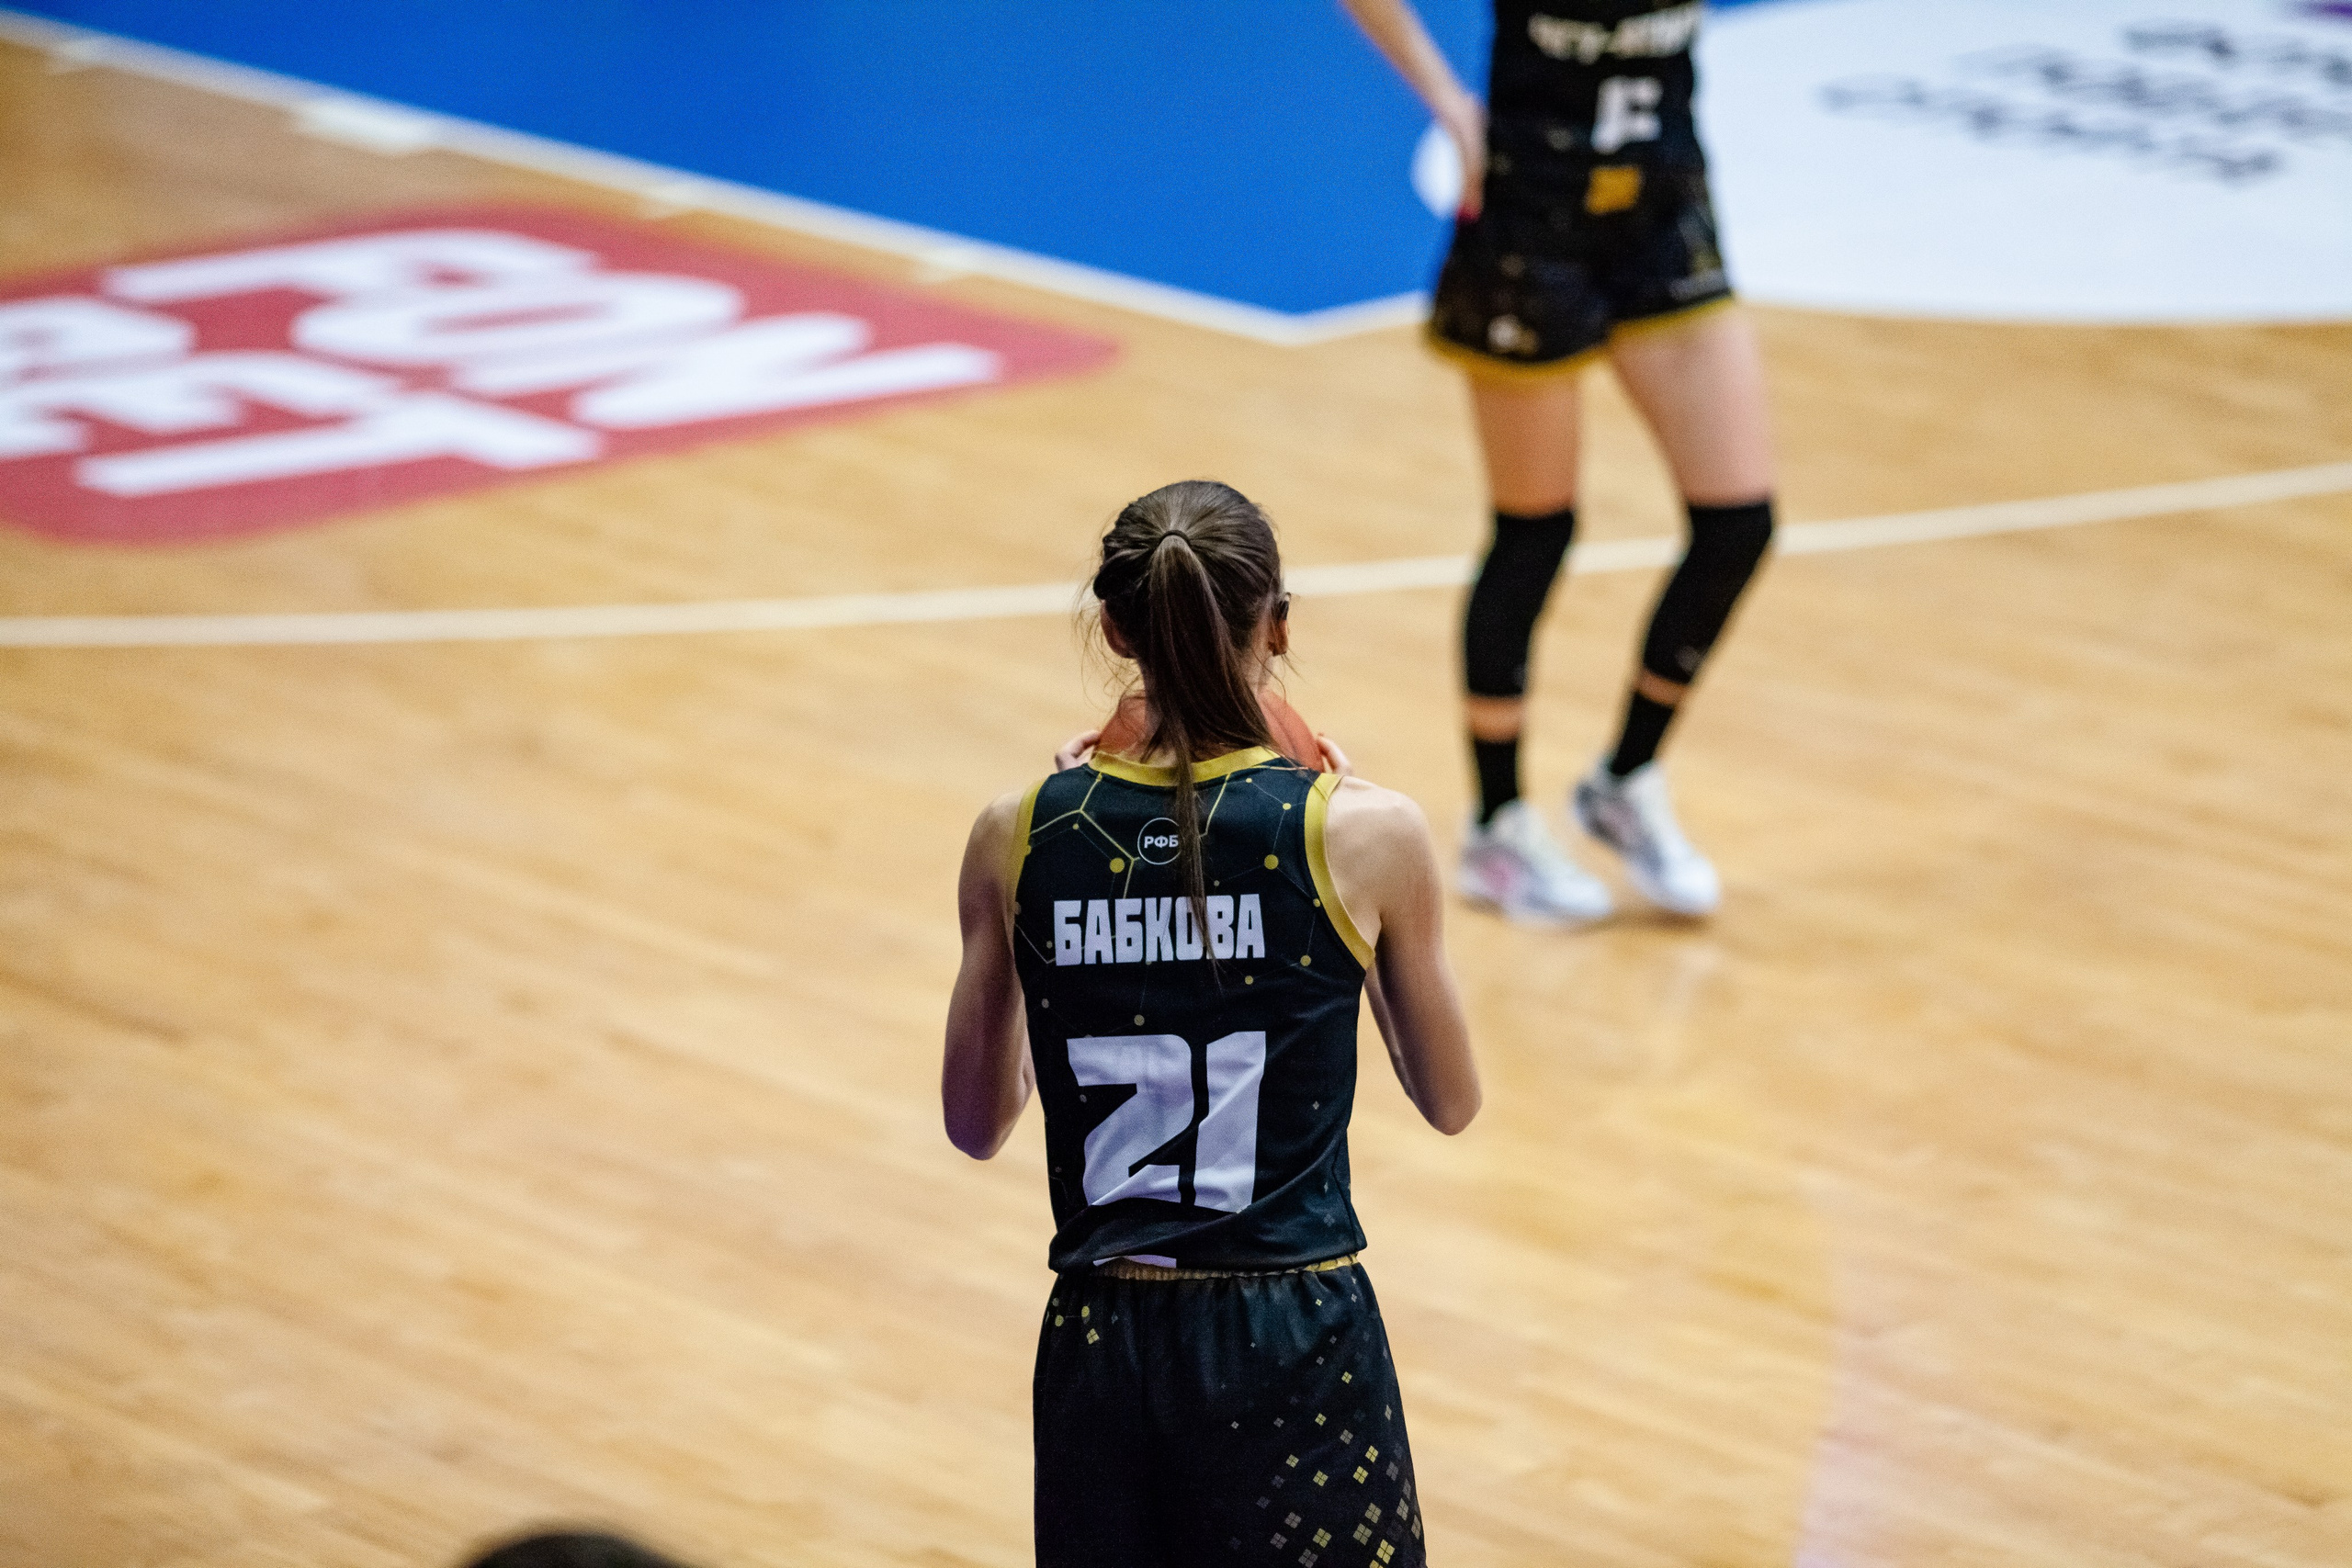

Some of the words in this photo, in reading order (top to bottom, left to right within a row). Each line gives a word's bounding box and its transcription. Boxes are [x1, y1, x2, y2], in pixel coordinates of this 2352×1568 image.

[1143, 834, 1180, 849] РФБ
[1053, 893, 1266, 966] БАБКОВА
[1066, 1030, 1267, 1214] 21
